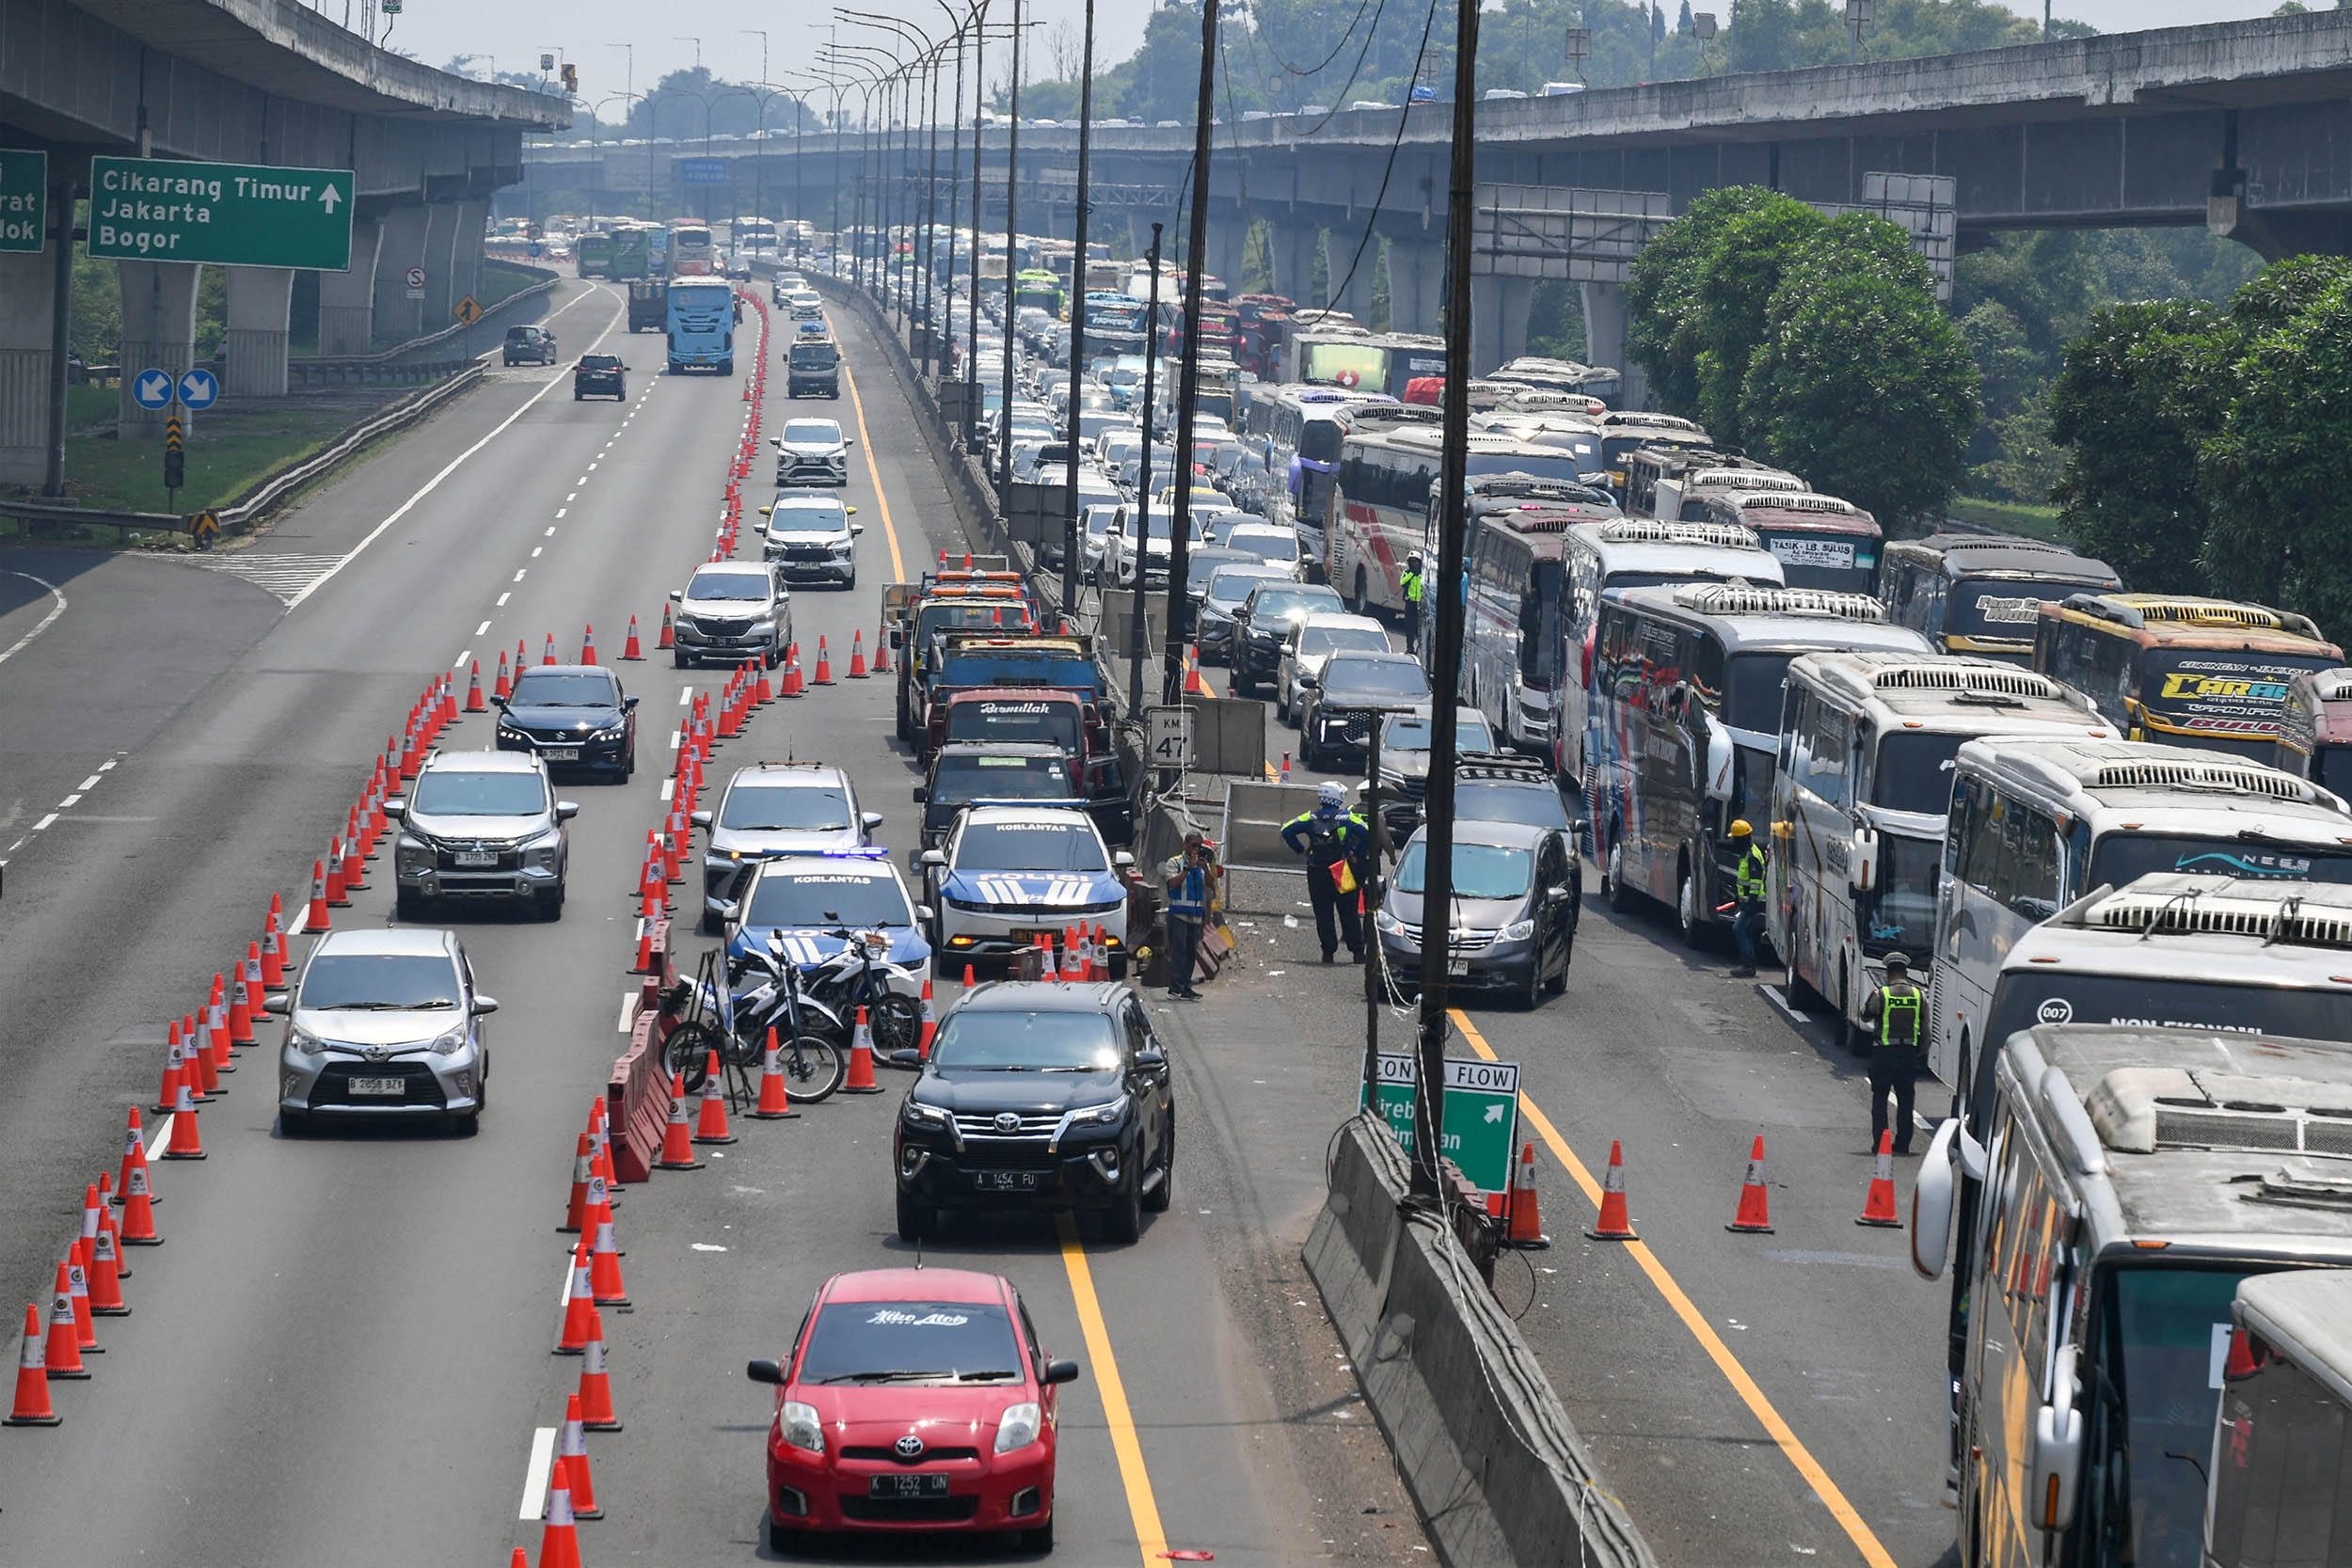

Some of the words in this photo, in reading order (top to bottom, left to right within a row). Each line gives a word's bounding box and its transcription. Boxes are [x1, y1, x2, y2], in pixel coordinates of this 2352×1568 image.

[103, 169, 222, 202] Cikarang
[234, 177, 311, 201] Timur
[102, 198, 211, 224] Jakarta
[100, 225, 181, 254] Bogor
[1164, 718, 1180, 729] KM
[1155, 736, 1188, 758] 47
[996, 823, 1067, 832] KORLANTAS
[793, 876, 871, 885] KORLANTAS
[978, 873, 1090, 882] POLISI
[2042, 1006, 2068, 1019] 007
[1457, 1066, 1509, 1087] FLOW
[977, 1173, 983, 1184] A
[993, 1173, 1013, 1184] 1454
[1023, 1173, 1035, 1185] FU
[871, 1475, 879, 1490] K
[894, 1475, 921, 1490] 1252
